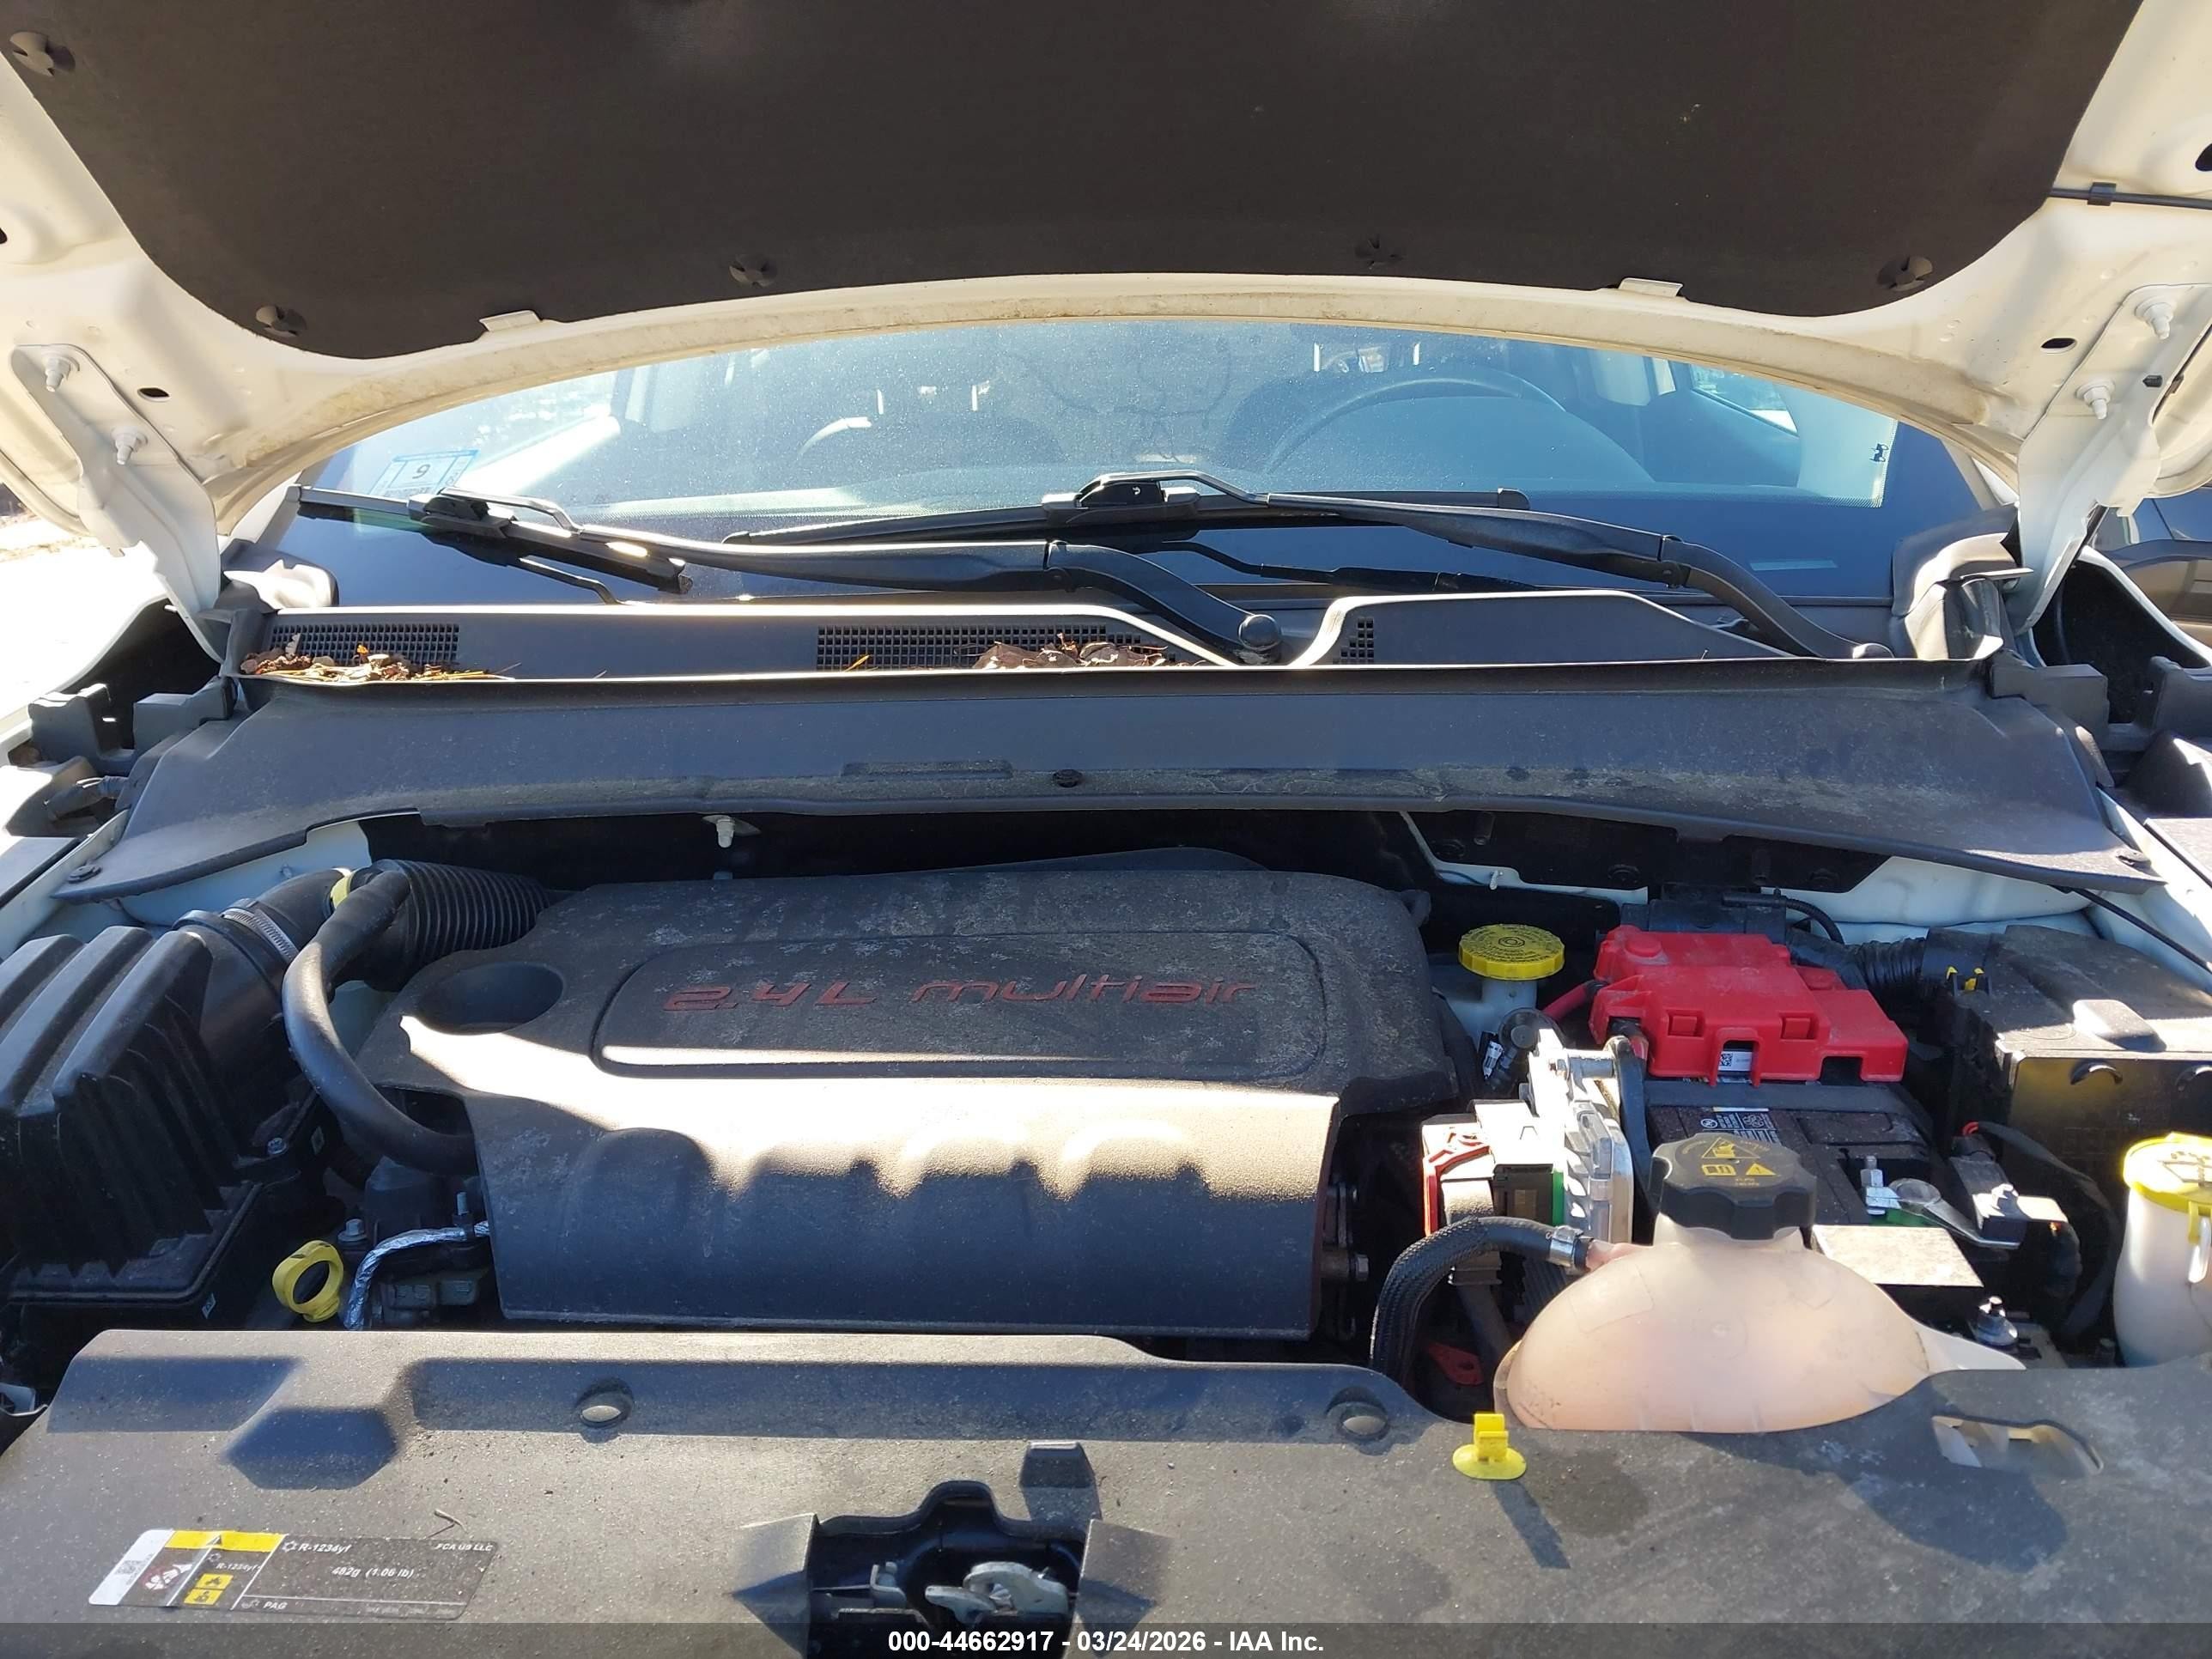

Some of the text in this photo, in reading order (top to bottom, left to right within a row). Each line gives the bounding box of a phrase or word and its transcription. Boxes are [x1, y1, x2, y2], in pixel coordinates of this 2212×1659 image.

[910, 972, 1258, 1005] multiair
[297, 1542, 353, 1554] R-1234yf
[473, 1542, 495, 1552] LLC
[262, 1601, 288, 1610] PAG
